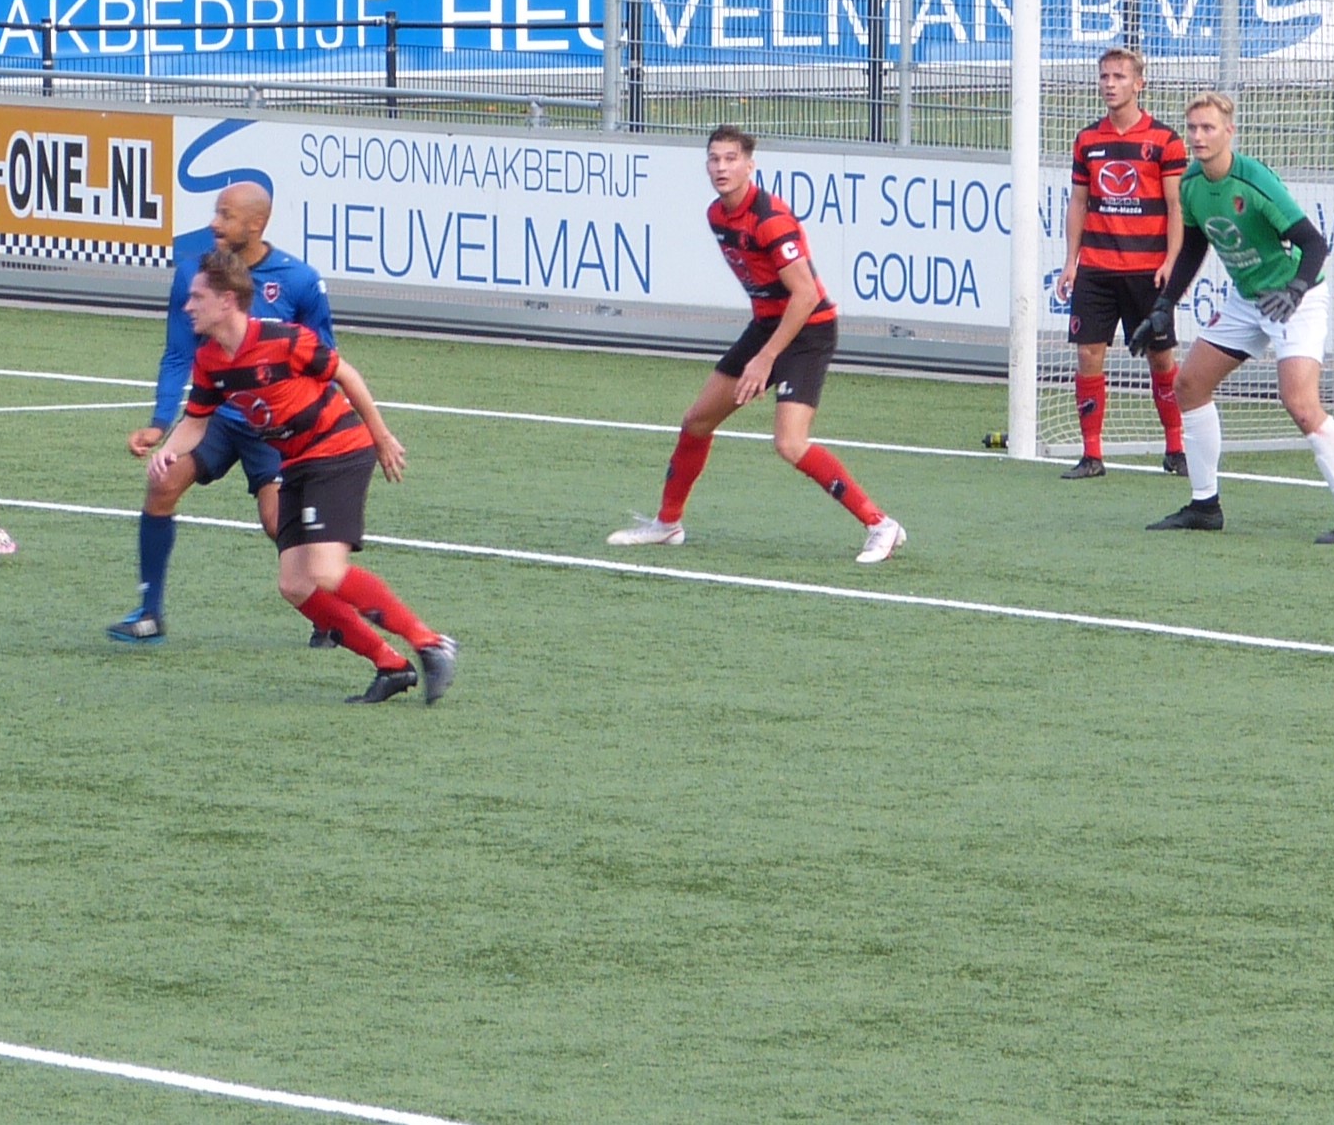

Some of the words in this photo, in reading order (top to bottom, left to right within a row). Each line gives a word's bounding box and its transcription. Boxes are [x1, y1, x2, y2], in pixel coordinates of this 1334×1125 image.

[300, 132, 650, 199] SCHOONMAAKBEDRIJF
[302, 200, 651, 295] HEUVELMAN
[853, 250, 980, 309] GOUDA
